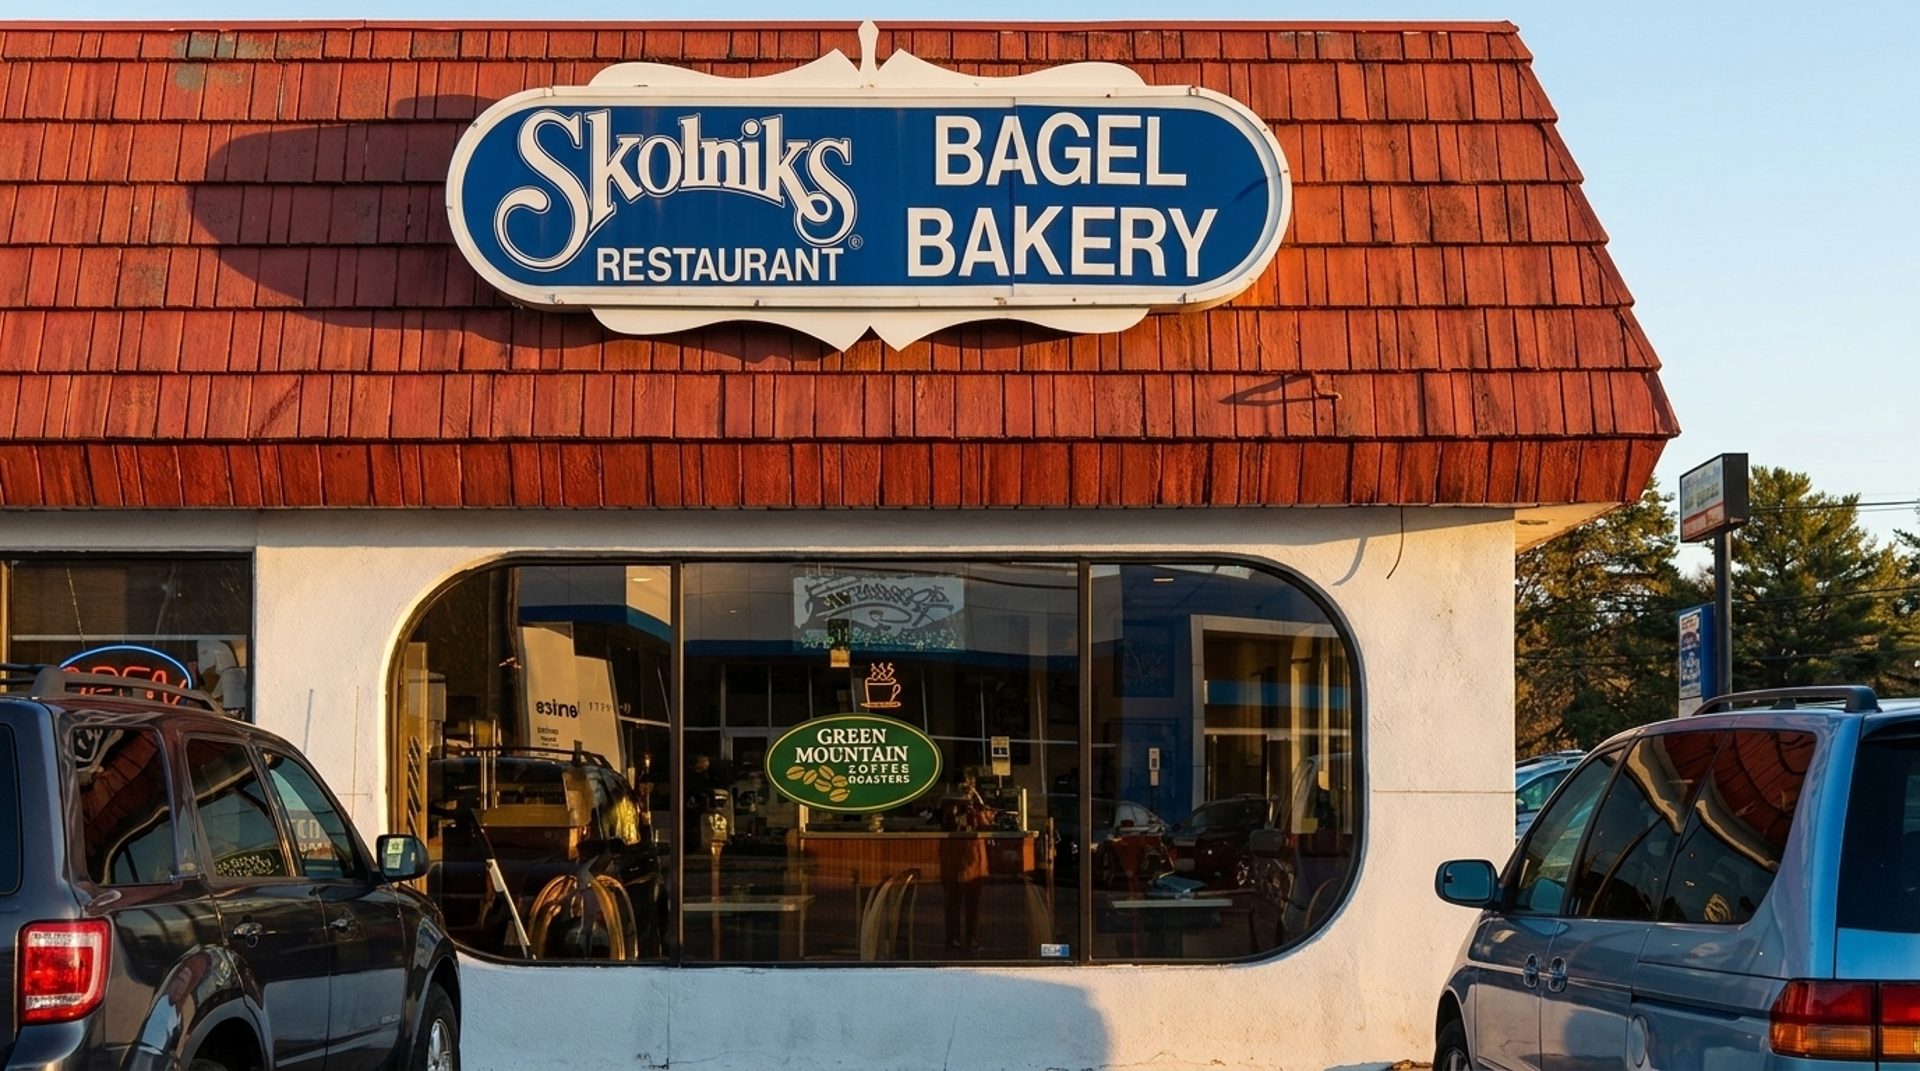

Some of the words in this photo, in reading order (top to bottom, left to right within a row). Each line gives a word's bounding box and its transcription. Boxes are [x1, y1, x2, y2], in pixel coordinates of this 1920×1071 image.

[935, 112, 1188, 188] BAGEL
[494, 109, 855, 270] Skolniks
[596, 245, 843, 282] RESTAURANT
[907, 206, 1218, 279] BAKERY
[795, 745, 909, 764] MOUNTAIN
[816, 728, 887, 745] GREEN
